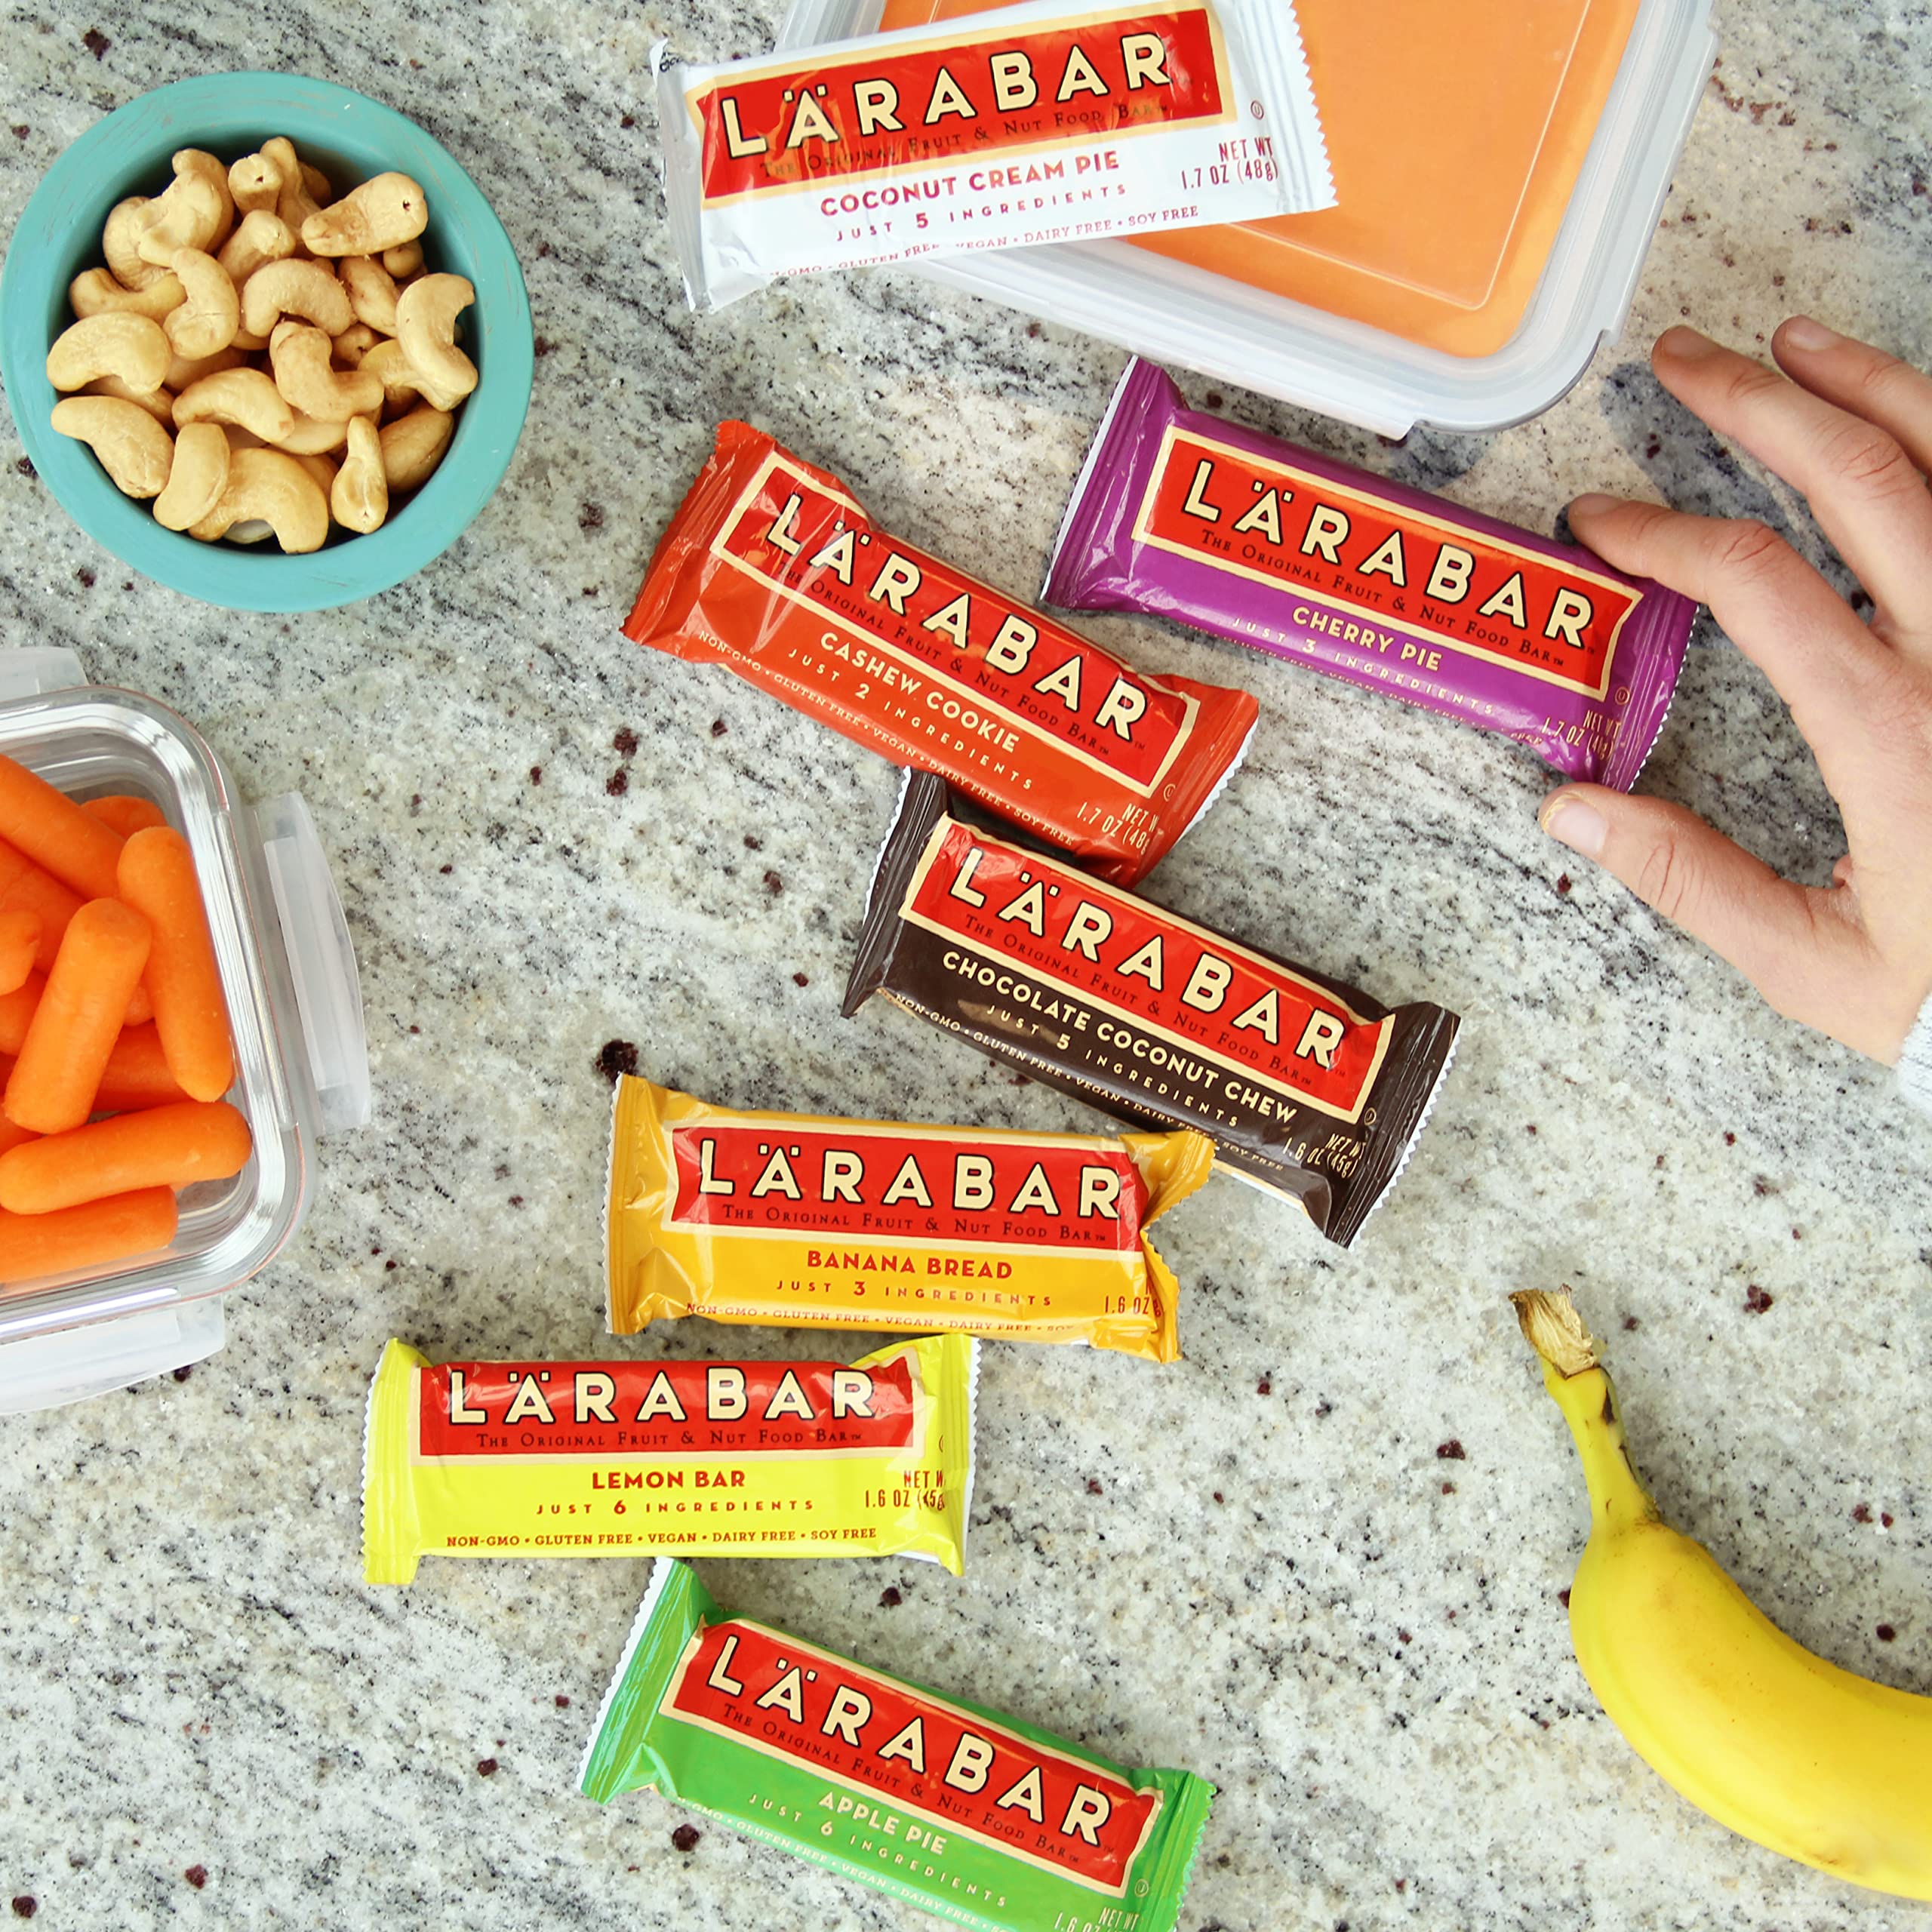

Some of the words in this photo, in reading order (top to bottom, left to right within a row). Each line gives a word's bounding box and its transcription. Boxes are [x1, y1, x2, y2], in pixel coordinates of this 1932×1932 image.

[721, 32, 1171, 160] LÄRABAR
[909, 133, 961, 151] FRUIT
[974, 126, 989, 140] &
[1004, 119, 1042, 136] NUT
[1055, 110, 1101, 127] FOOD
[1219, 140, 1248, 162] NET
[1257, 137, 1273, 158] WT
[820, 177, 957, 217] COCONUT
[969, 159, 1065, 192] CREAM
[1075, 151, 1119, 174] PIE
[1181, 168, 1202, 190] 1.7
[1210, 164, 1229, 185] OZ
[1236, 158, 1278, 183] (48g)
[837, 222, 892, 242] JUST
[915, 213, 929, 229] 5
[949, 183, 1126, 222] INGREDIENTS
[1024, 226, 1070, 243] DAIRY
[1075, 220, 1112, 236] FREE
[1128, 213, 1156, 226] SOY
[1162, 205, 1199, 221] FREE
[1183, 460, 1594, 648] LÄRABAR
[1202, 529, 1230, 552] THE
[1241, 544, 1321, 583] ORIGINAL
[1332, 574, 1383, 603] FRUIT
[1392, 597, 1406, 612] &
[1419, 605, 1456, 627] NUT
[1465, 620, 1509, 647] FOOD
[768, 494, 1146, 741] LÄRABAR
[1292, 606, 1394, 654] CHERRY
[1401, 641, 1443, 672] PIE
[811, 579, 884, 630] ORIGINAL
[894, 627, 942, 660] FRUIT
[950, 658, 963, 674] &
[975, 673, 1010, 699] NUT
[1017, 695, 1059, 727] FOOD
[1232, 618, 1286, 642] JUST
[1302, 638, 1316, 654] 3
[1335, 652, 1493, 714] INGREDIENTS
[788, 648, 839, 682] JUST
[855, 682, 869, 700] 2
[884, 701, 1032, 790] INGREDIENTS
[820, 632, 921, 695] CASHEW
[926, 691, 1020, 753] COOKIE
[1583, 709, 1603, 732] NET
[698, 630, 762, 672] NON-GMO
[774, 673, 826, 706] GLUTEN
[829, 703, 861, 728] FREE
[872, 728, 917, 758] VEGAN
[929, 760, 969, 787] DAIRY
[971, 783, 1004, 808] FREE
[1014, 807, 1041, 827] SOY
[1042, 823, 1075, 847] FREE
[1566, 725, 1586, 747] OZ
[1077, 801, 1102, 825] 1.7
[1102, 815, 1123, 838] OZ
[1121, 803, 1149, 827] NET
[950, 848, 1345, 1071] LÄRABAR
[964, 914, 993, 938] THE
[1003, 933, 1079, 980] ORIGINAL
[1090, 974, 1138, 1005] FRUIT
[1147, 1001, 1160, 1016] &
[1172, 1012, 1208, 1038] NUT
[1217, 1031, 1259, 1061] FOOD
[942, 951, 1091, 1032] CHOCOLATE
[1097, 1023, 1220, 1089] COCONUT
[1224, 1080, 1298, 1124] CHEW
[987, 1004, 1041, 1035] JUST
[1056, 1033, 1071, 1051] 5
[1085, 1049, 1238, 1128] INGREDIENTS
[896, 992, 962, 1035] NON-GMO
[973, 1031, 1026, 1063] GLUTEN
[1030, 1055, 1063, 1079] FREE
[1075, 1075, 1121, 1103] VEGAN
[1134, 1103, 1174, 1124] DAIRY
[1222, 1142, 1249, 1157] SOY
[1251, 1155, 1284, 1171] FREE
[1282, 1137, 1307, 1161] 1.6
[1324, 1133, 1352, 1152] NET
[700, 1140, 1121, 1219] LÄRABAR
[723, 1204, 753, 1220] THE
[766, 1208, 850, 1226] ORIGINAL
[863, 1213, 913, 1229] FRUIT
[925, 1217, 939, 1231] &
[954, 1219, 991, 1234] NUT
[1003, 1222, 1048, 1238] FOOD
[777, 1280, 832, 1293] JUST
[853, 1281, 866, 1296] 3
[885, 1286, 1051, 1306] INGREDIENTS
[807, 1250, 916, 1274] BANANA
[927, 1257, 1013, 1279] BREAD
[685, 1302, 758, 1318] NON-GMO
[772, 1309, 830, 1321] GLUTEN
[835, 1312, 869, 1324] FREE
[884, 1316, 934, 1328] VEGAN
[1105, 1295, 1125, 1314] 1.6
[1133, 1297, 1150, 1315] OZ
[449, 1367, 875, 1425] LÄRABAR
[477, 1433, 508, 1447] THE
[521, 1432, 605, 1447] ORIGINAL
[618, 1432, 669, 1446] FRUIT
[681, 1431, 694, 1444] &
[710, 1430, 746, 1444] NUT
[758, 1429, 803, 1444] FOOD
[537, 1503, 592, 1515] JUST
[614, 1500, 626, 1515] 6
[646, 1500, 814, 1513] INGREDIENTS
[592, 1471, 684, 1490] LEMON
[695, 1470, 746, 1487] BAR
[866, 1489, 885, 1508] 1.6
[894, 1489, 910, 1507] OZ
[904, 1470, 930, 1488] NET
[446, 1535, 520, 1547] NON-GMO
[535, 1534, 592, 1546] GLUTEN
[598, 1534, 632, 1545] FREE
[648, 1532, 697, 1544] VEGAN
[712, 1531, 755, 1543] DAIRY
[761, 1530, 795, 1541] FREE
[811, 1529, 838, 1540] SOY
[843, 1527, 876, 1540] FREE
[708, 1635, 1110, 1847] LÄRABAR
[724, 1703, 752, 1727] THE
[763, 1721, 840, 1764] ORIGINAL
[851, 1759, 900, 1789] FRUIT
[912, 1783, 924, 1798] &
[937, 1793, 972, 1818] NUT
[982, 1811, 1025, 1840] FOOD
[749, 1794, 802, 1823] JUST
[820, 1821, 833, 1837] 6
[850, 1835, 1006, 1907] INGREDIENTS
[819, 1791, 900, 1835] APPLE
[905, 1825, 948, 1856] PIE
[736, 1821, 789, 1847] GLUTEN
[795, 1843, 828, 1863] FREE
[841, 1863, 886, 1887] VEGAN
[900, 1886, 942, 1910] DAIRY
[945, 1906, 980, 1927] FREE
[1097, 1906, 1124, 1928] NET
